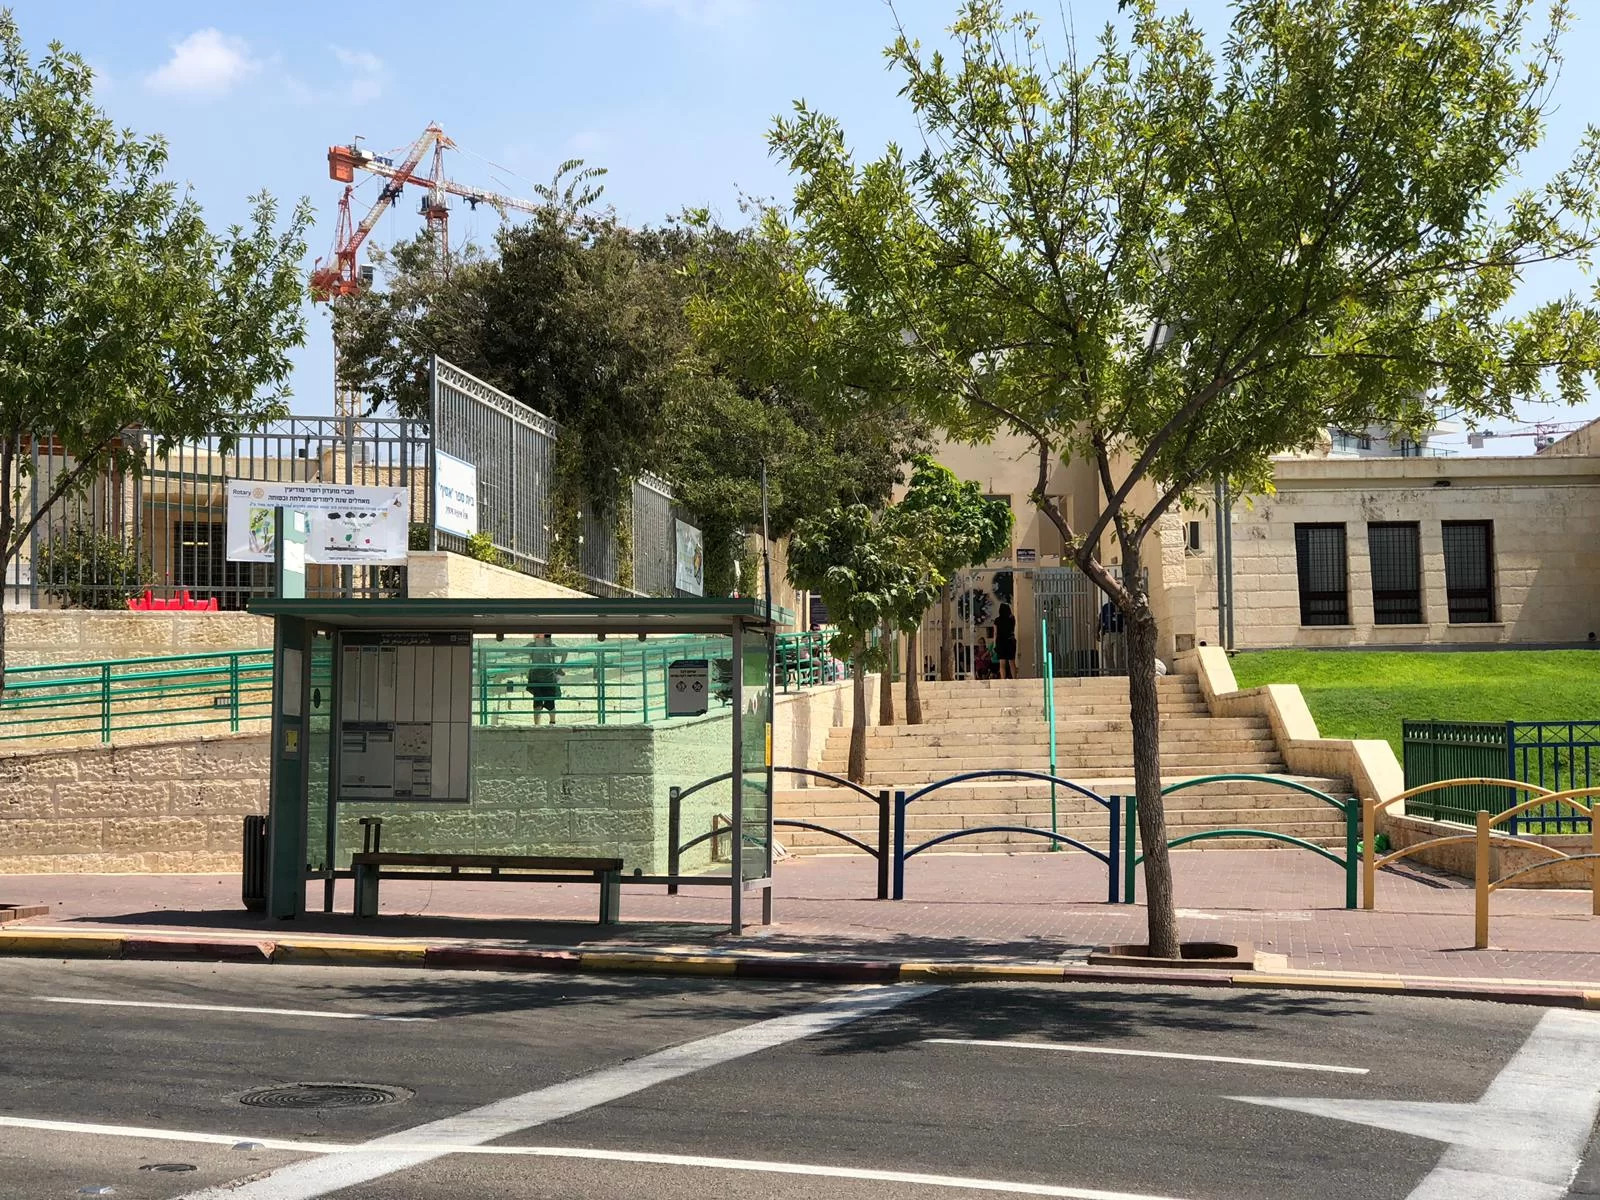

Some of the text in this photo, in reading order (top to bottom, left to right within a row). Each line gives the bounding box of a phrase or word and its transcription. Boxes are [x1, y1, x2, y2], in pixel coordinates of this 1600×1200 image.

[232, 488, 252, 496] Rotary
[454, 490, 465, 503] ספר
[465, 494, 475, 507] בית
